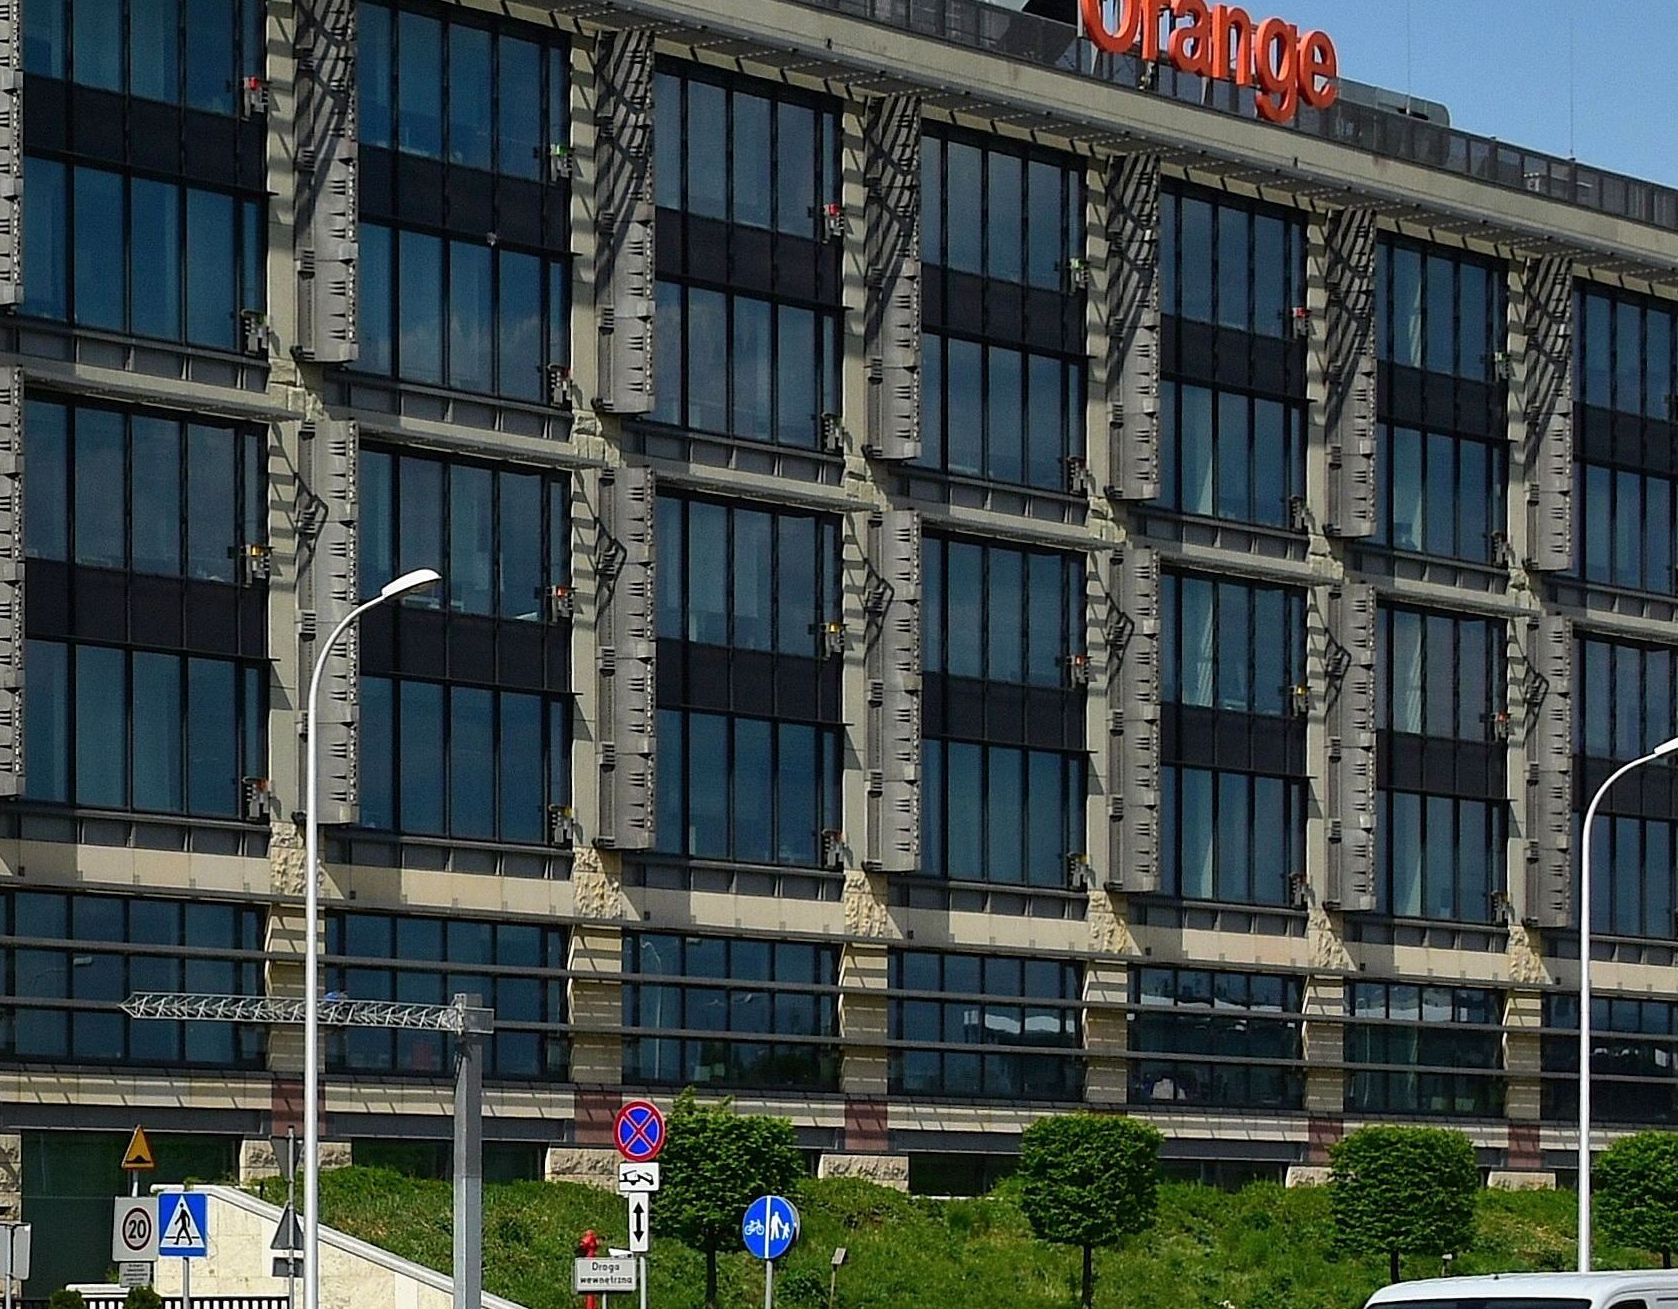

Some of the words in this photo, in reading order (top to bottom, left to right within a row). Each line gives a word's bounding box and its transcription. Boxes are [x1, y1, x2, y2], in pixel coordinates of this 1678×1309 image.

[128, 1219, 147, 1239] 20
[592, 1262, 620, 1273] Droga
[580, 1276, 632, 1285] wewnętrzna
